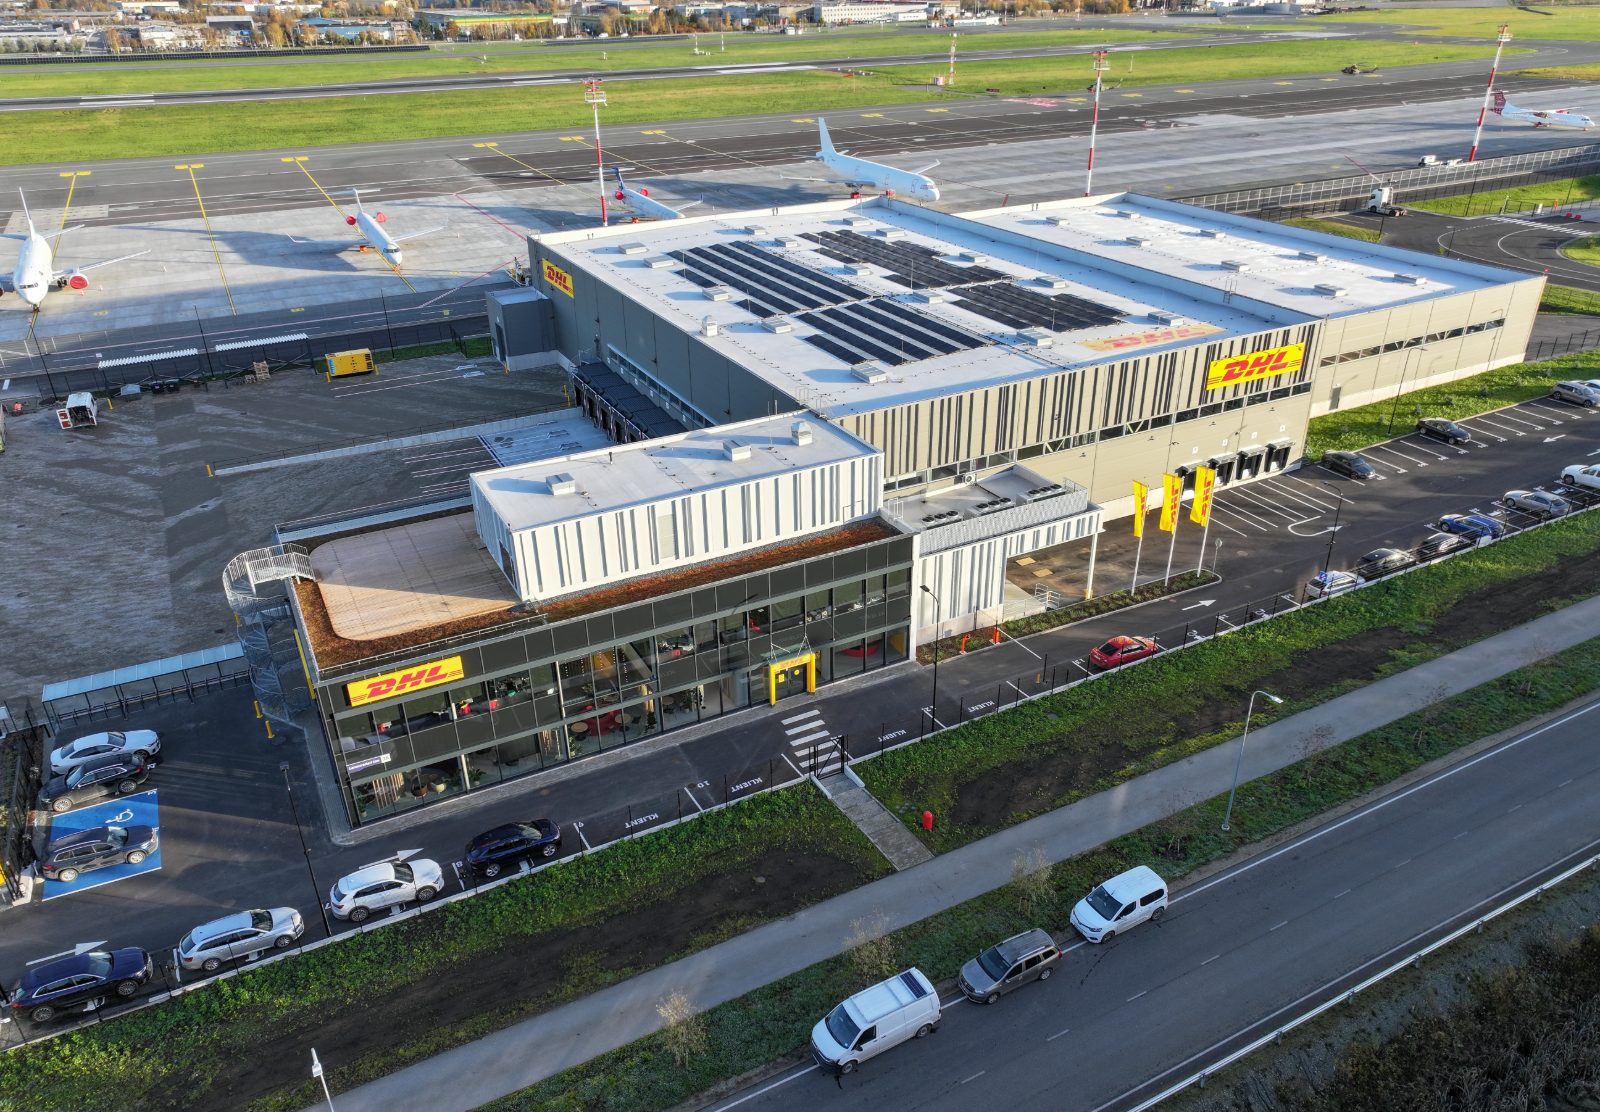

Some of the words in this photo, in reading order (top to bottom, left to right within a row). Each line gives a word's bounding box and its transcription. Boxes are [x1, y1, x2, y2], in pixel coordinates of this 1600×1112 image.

[546, 265, 570, 291] DHL
[1103, 328, 1206, 348] DHL
[1220, 351, 1289, 382] DHL
[366, 665, 449, 699] DHL
[967, 700, 995, 713] KLIENT
[878, 729, 907, 743] KLIENT
[697, 780, 710, 789] 10
[731, 777, 763, 793] KLIENT
[624, 812, 659, 829] KLIENT
